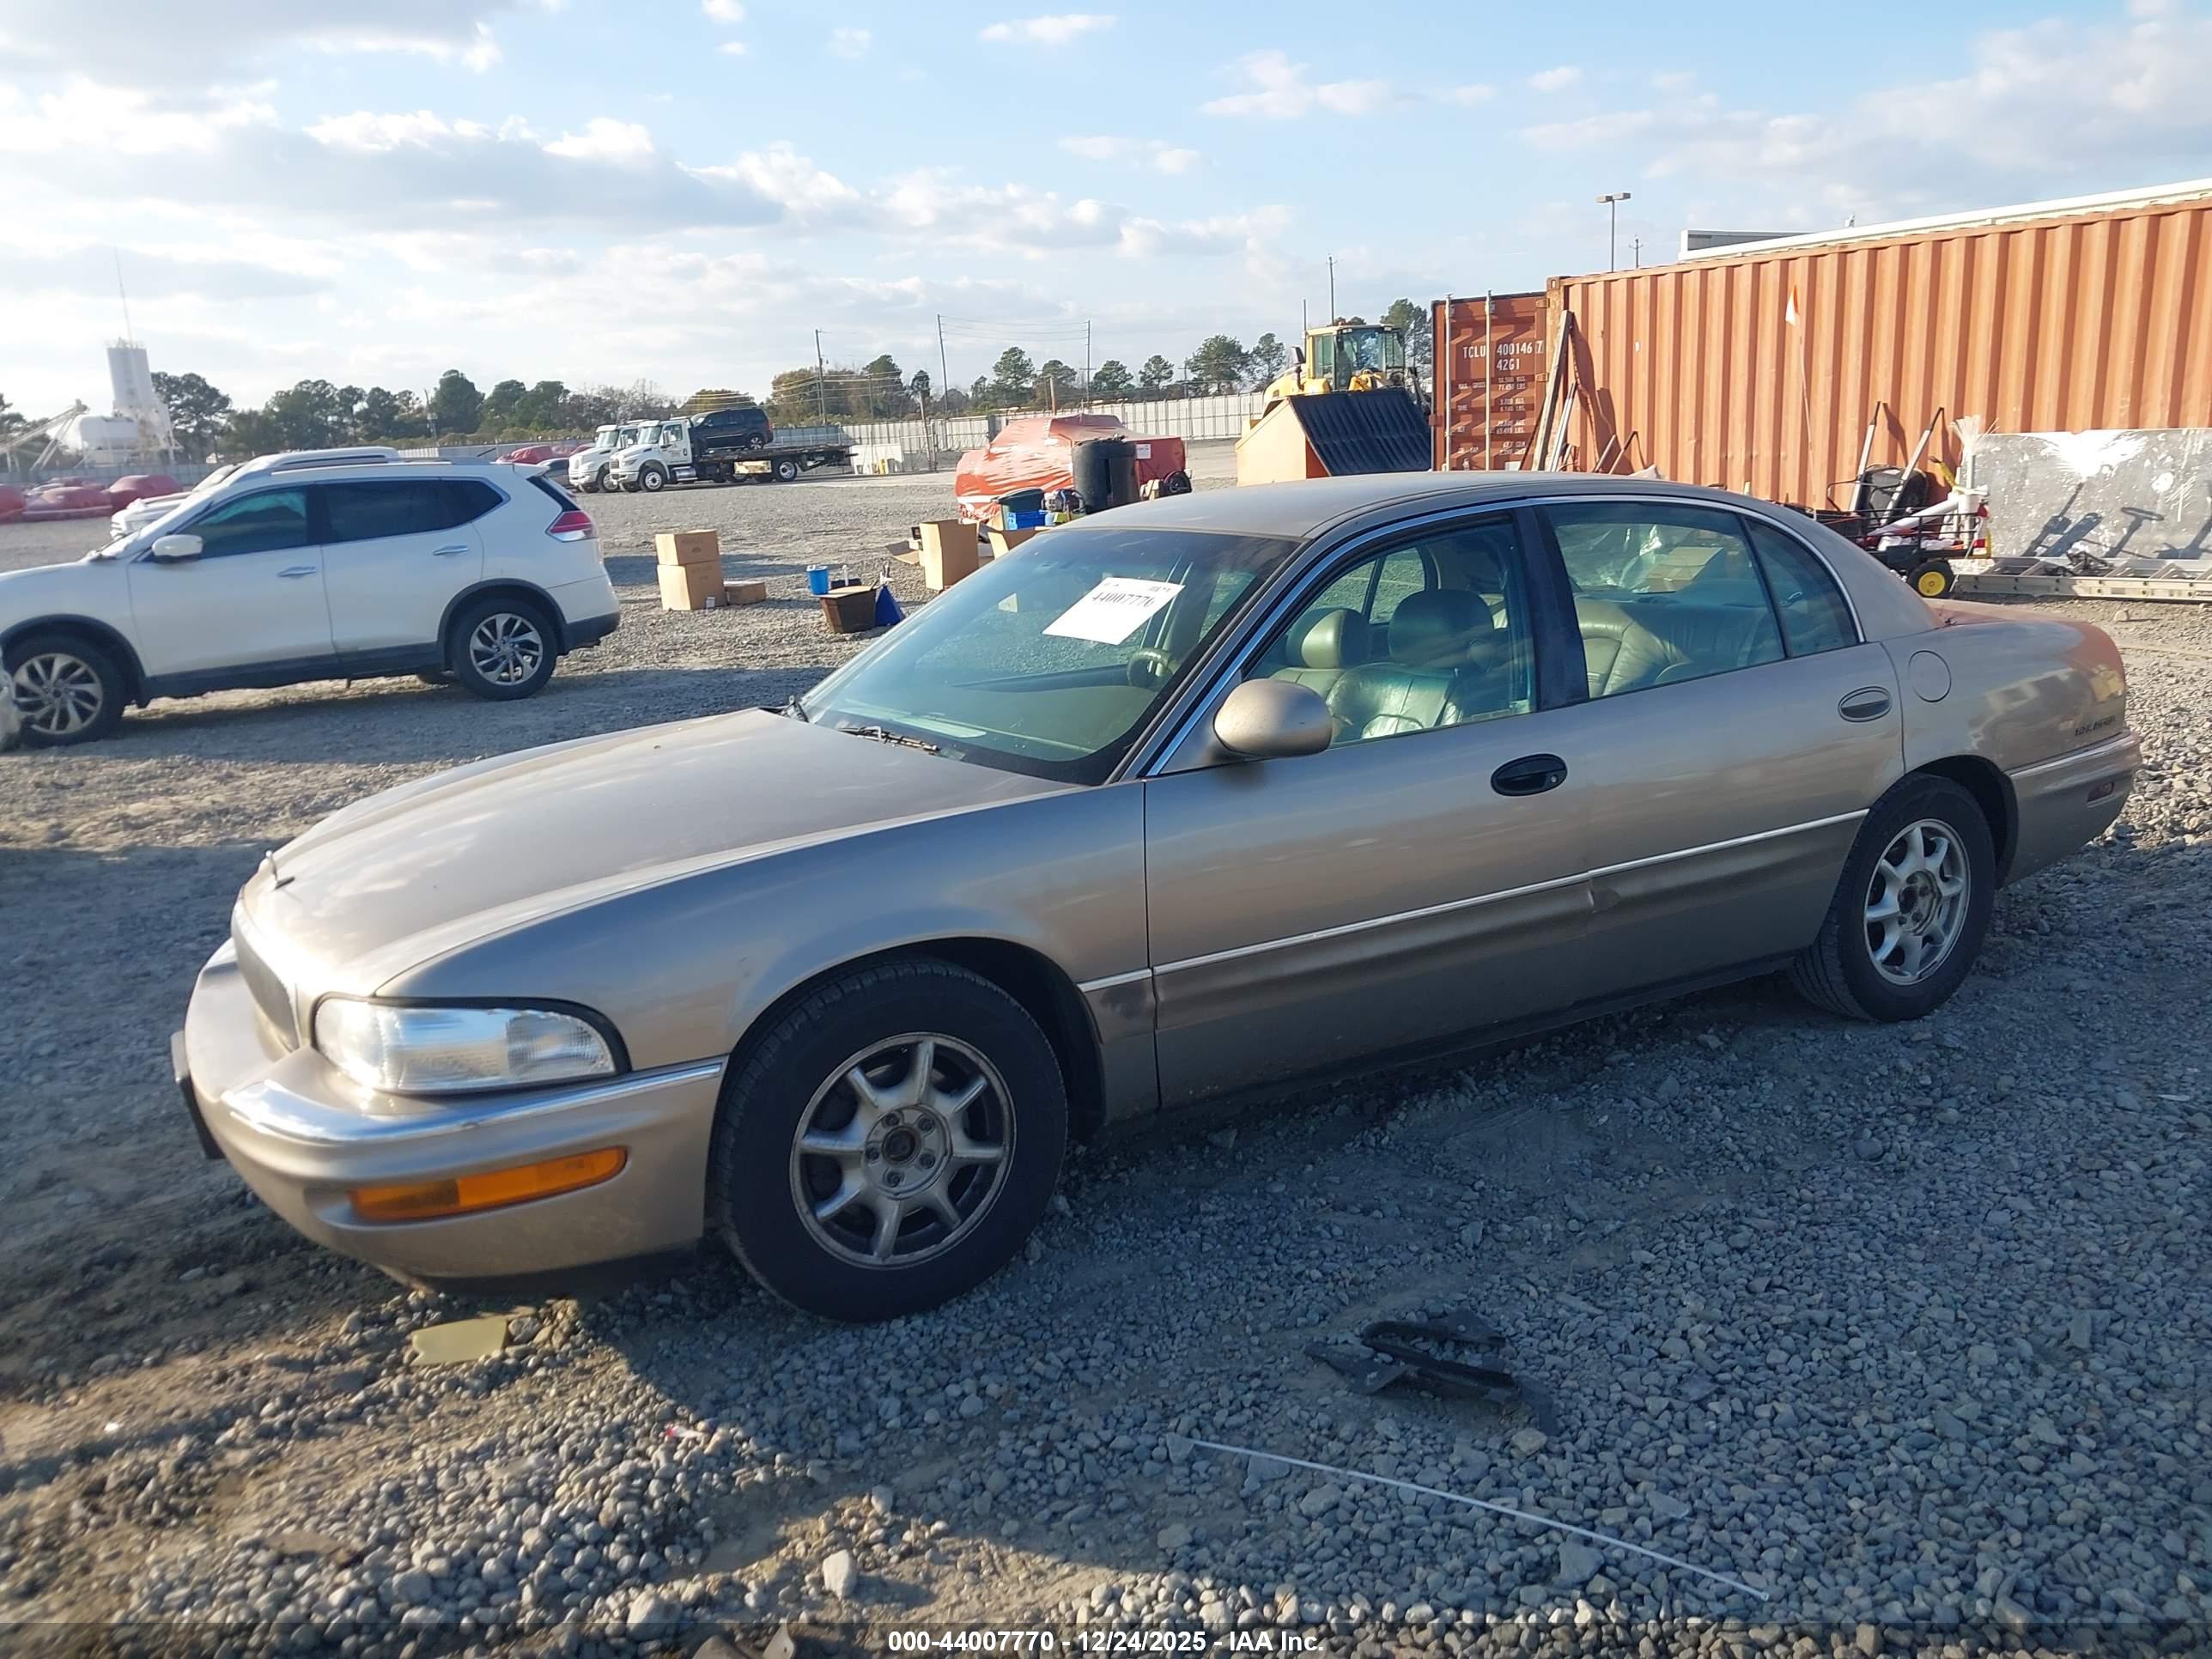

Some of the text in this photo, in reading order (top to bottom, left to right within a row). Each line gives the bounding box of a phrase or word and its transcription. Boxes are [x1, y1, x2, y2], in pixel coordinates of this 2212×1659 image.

[1462, 344, 1486, 359] TCLU
[1497, 342, 1533, 356] 400146
[1496, 357, 1520, 371] 42G1
